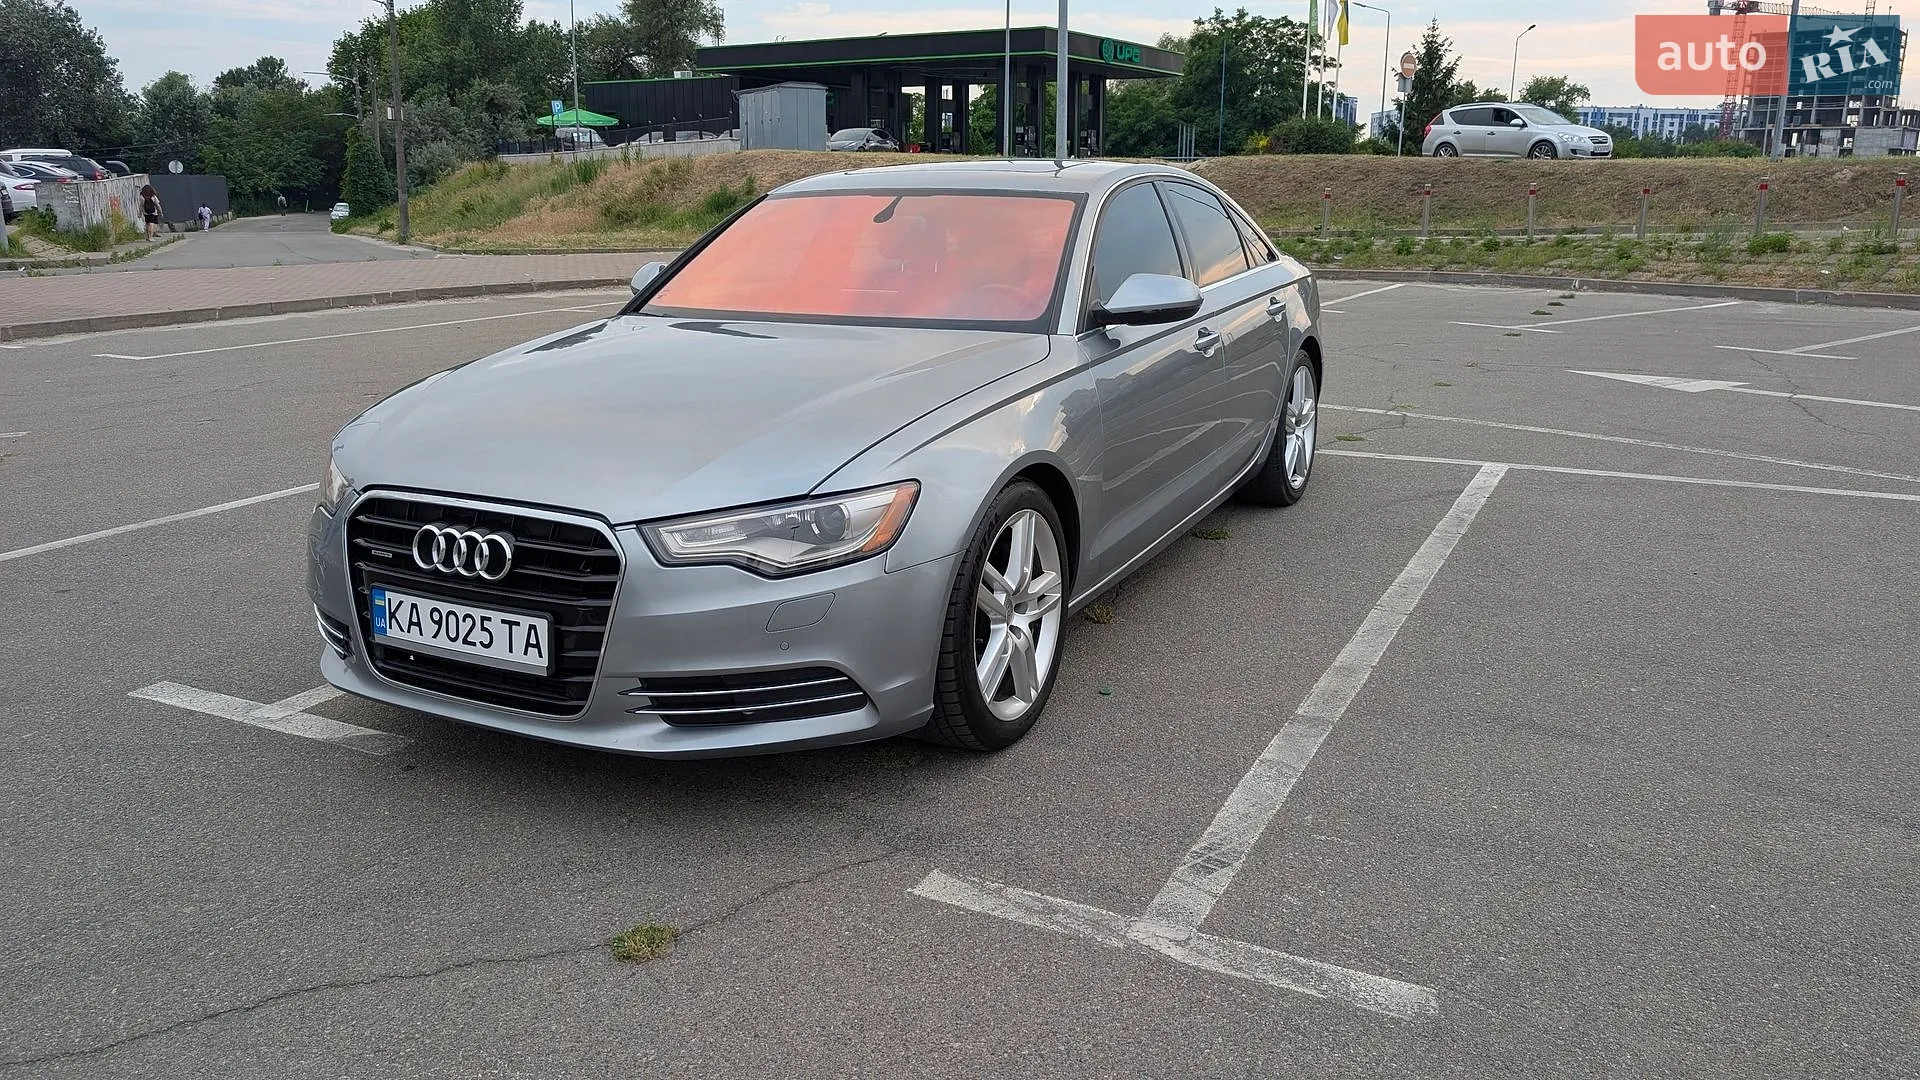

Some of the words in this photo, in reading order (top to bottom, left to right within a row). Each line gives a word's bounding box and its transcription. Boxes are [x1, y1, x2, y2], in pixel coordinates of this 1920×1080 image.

[554, 102, 561, 112] P
[375, 616, 386, 628] UA
[387, 597, 424, 637] KA
[429, 607, 493, 648] 9025
[501, 619, 543, 658] TA
